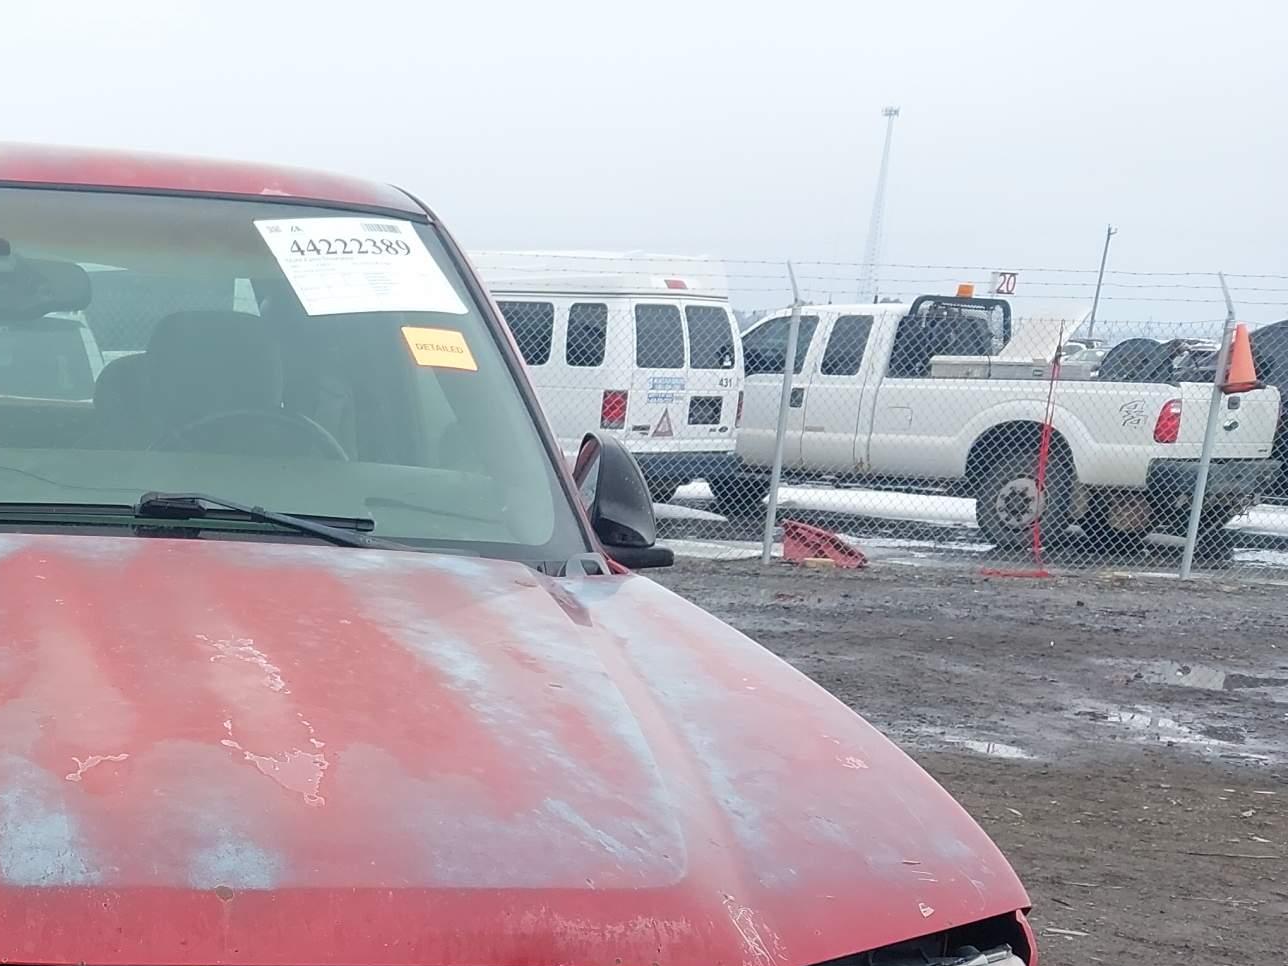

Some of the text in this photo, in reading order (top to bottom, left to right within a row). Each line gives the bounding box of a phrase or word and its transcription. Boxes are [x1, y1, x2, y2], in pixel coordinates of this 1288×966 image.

[290, 238, 411, 256] 44222389
[996, 272, 1017, 295] 20
[415, 343, 464, 354] DETAILED
[718, 377, 733, 388] 431
